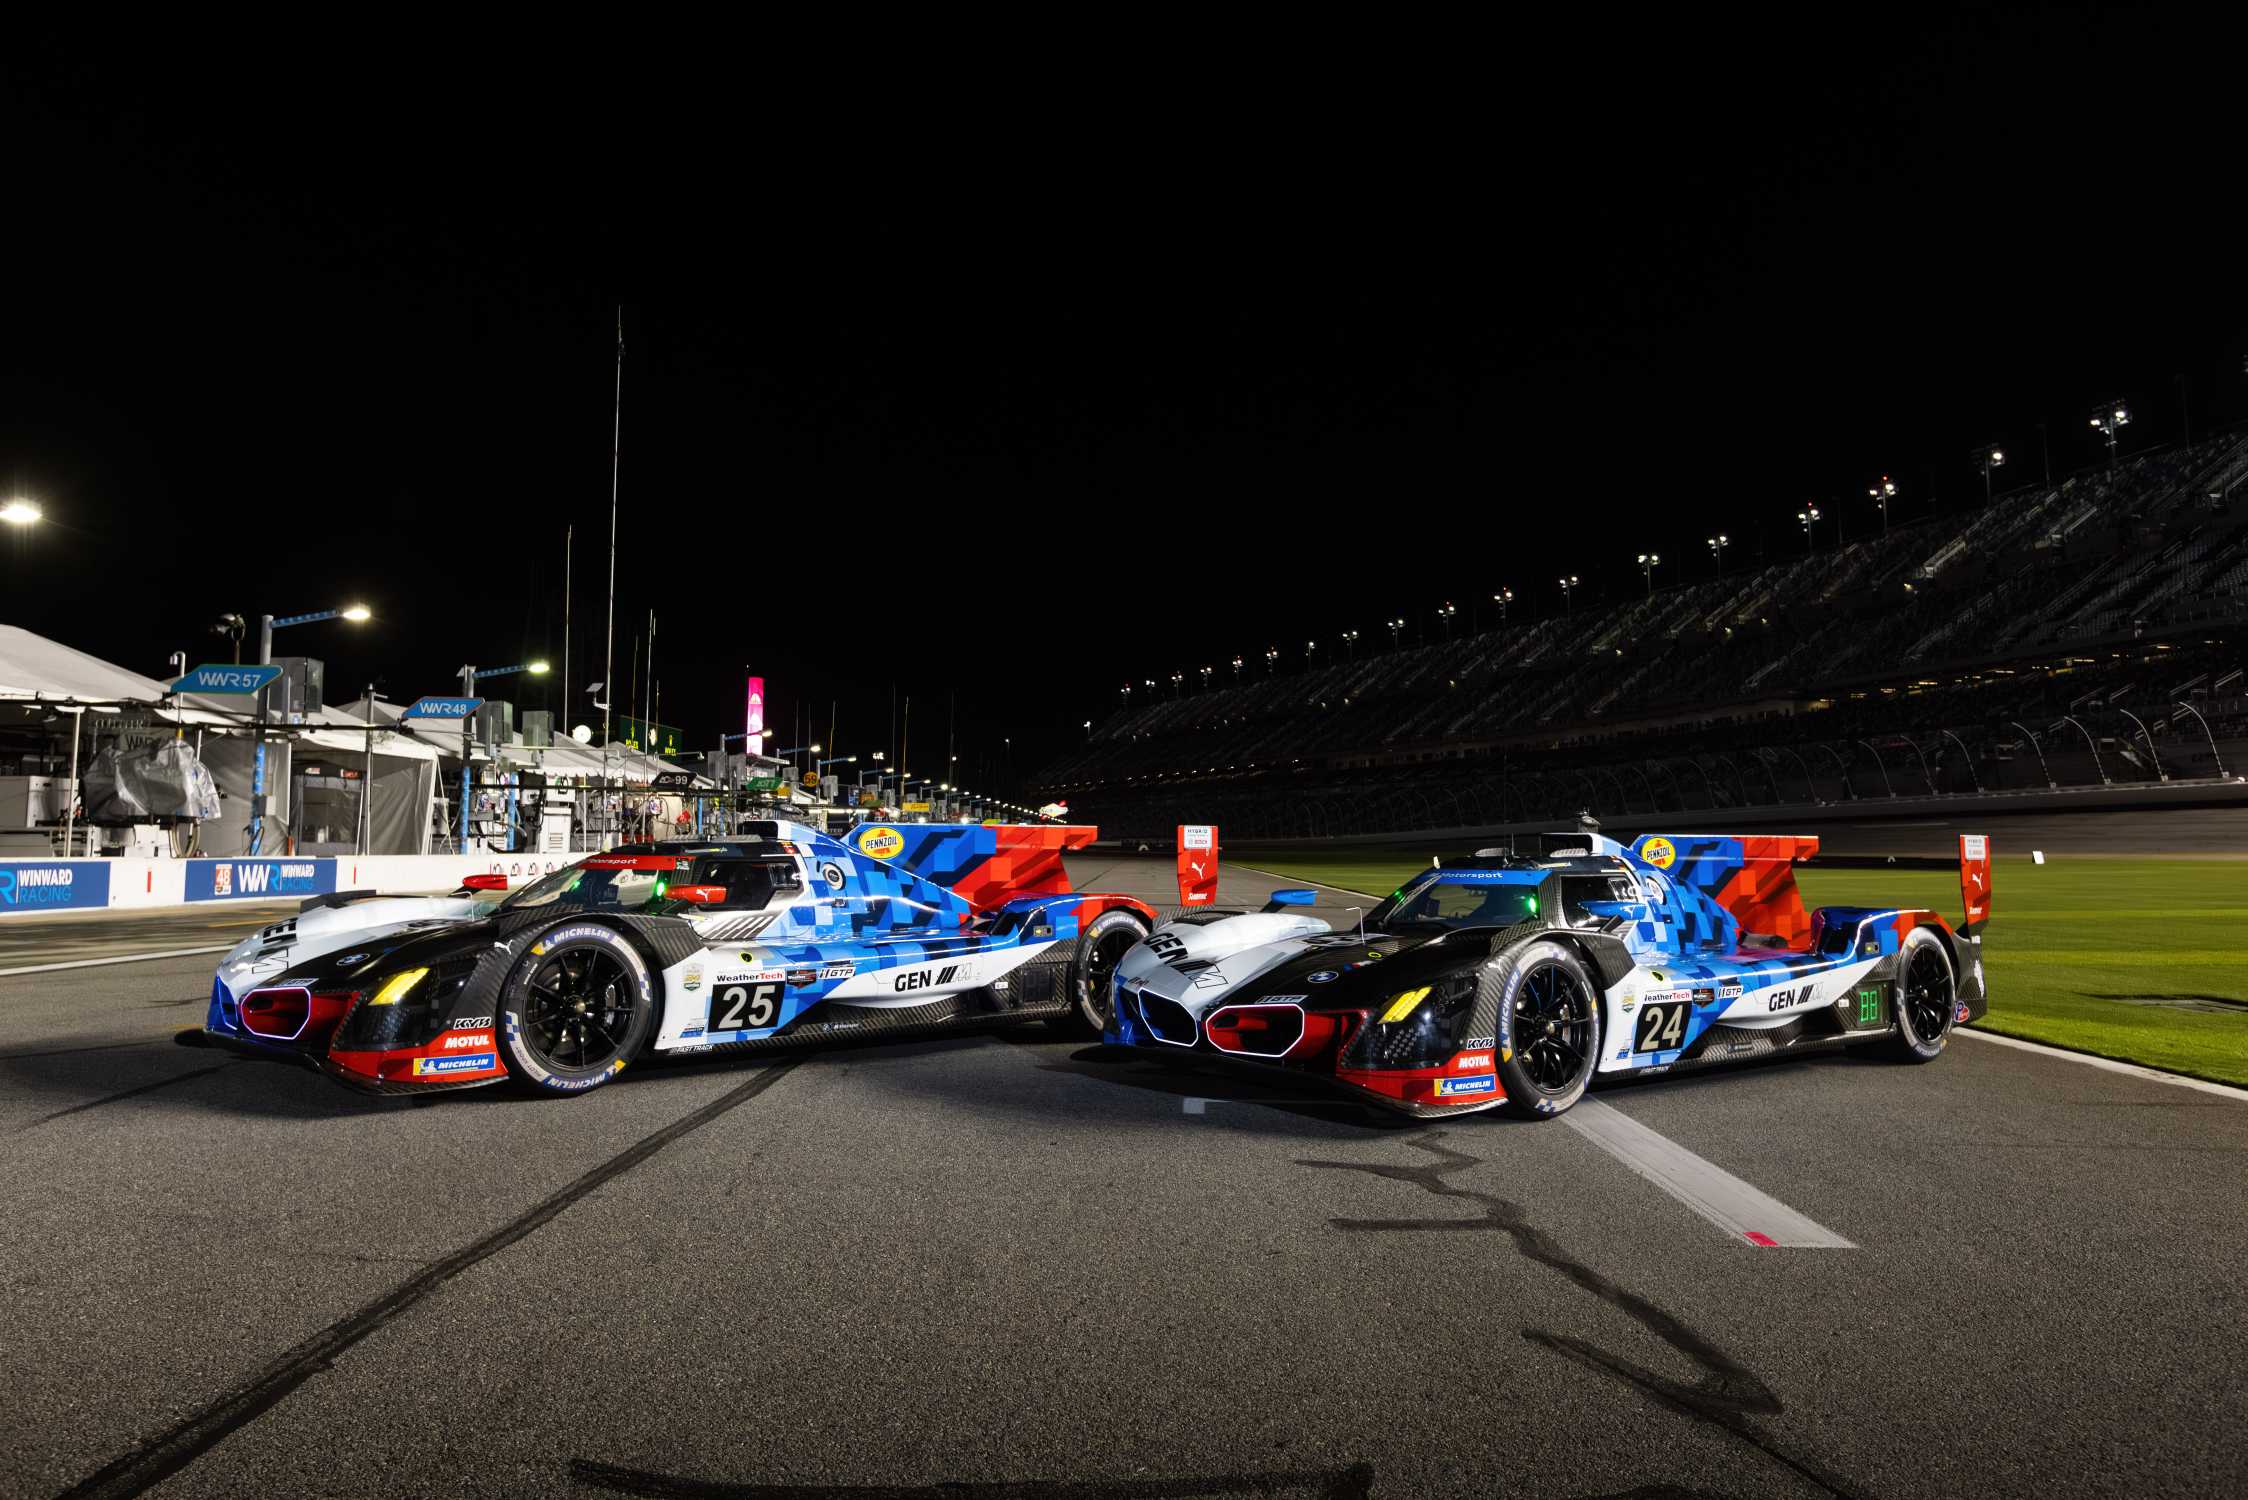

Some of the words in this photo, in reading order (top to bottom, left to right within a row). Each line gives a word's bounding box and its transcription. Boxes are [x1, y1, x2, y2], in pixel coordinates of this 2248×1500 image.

[242, 674, 261, 688] 57
[453, 703, 467, 715] 48
[675, 775, 688, 785] 99
[865, 835, 898, 850] PENNZOIL
[1646, 846, 1671, 861] PENNZOIL
[19, 868, 73, 887] WINWARD
[216, 869, 231, 885] 48
[281, 864, 315, 878] WINWARD
[20, 886, 72, 903] RACING
[553, 926, 611, 944] MICHELIN
[1143, 932, 1189, 965] GEN
[716, 972, 783, 982] WeatherTech
[830, 969, 853, 977] GTP
[894, 970, 932, 992] GEN
[718, 985, 776, 1029] 25
[1501, 970, 1520, 1036] MICHELIN
[1768, 989, 1796, 1012] GEN
[453, 1017, 491, 1030] KYB
[1640, 1004, 1684, 1051] 24
[444, 1035, 490, 1049] MOTUL
[1466, 1037, 1495, 1050] KYB
[437, 1058, 489, 1070] MICHELIN
[1459, 1056, 1490, 1069] MOTUL
[548, 1073, 607, 1090] MICHELIN
[1455, 1081, 1491, 1090] MICHELIN
